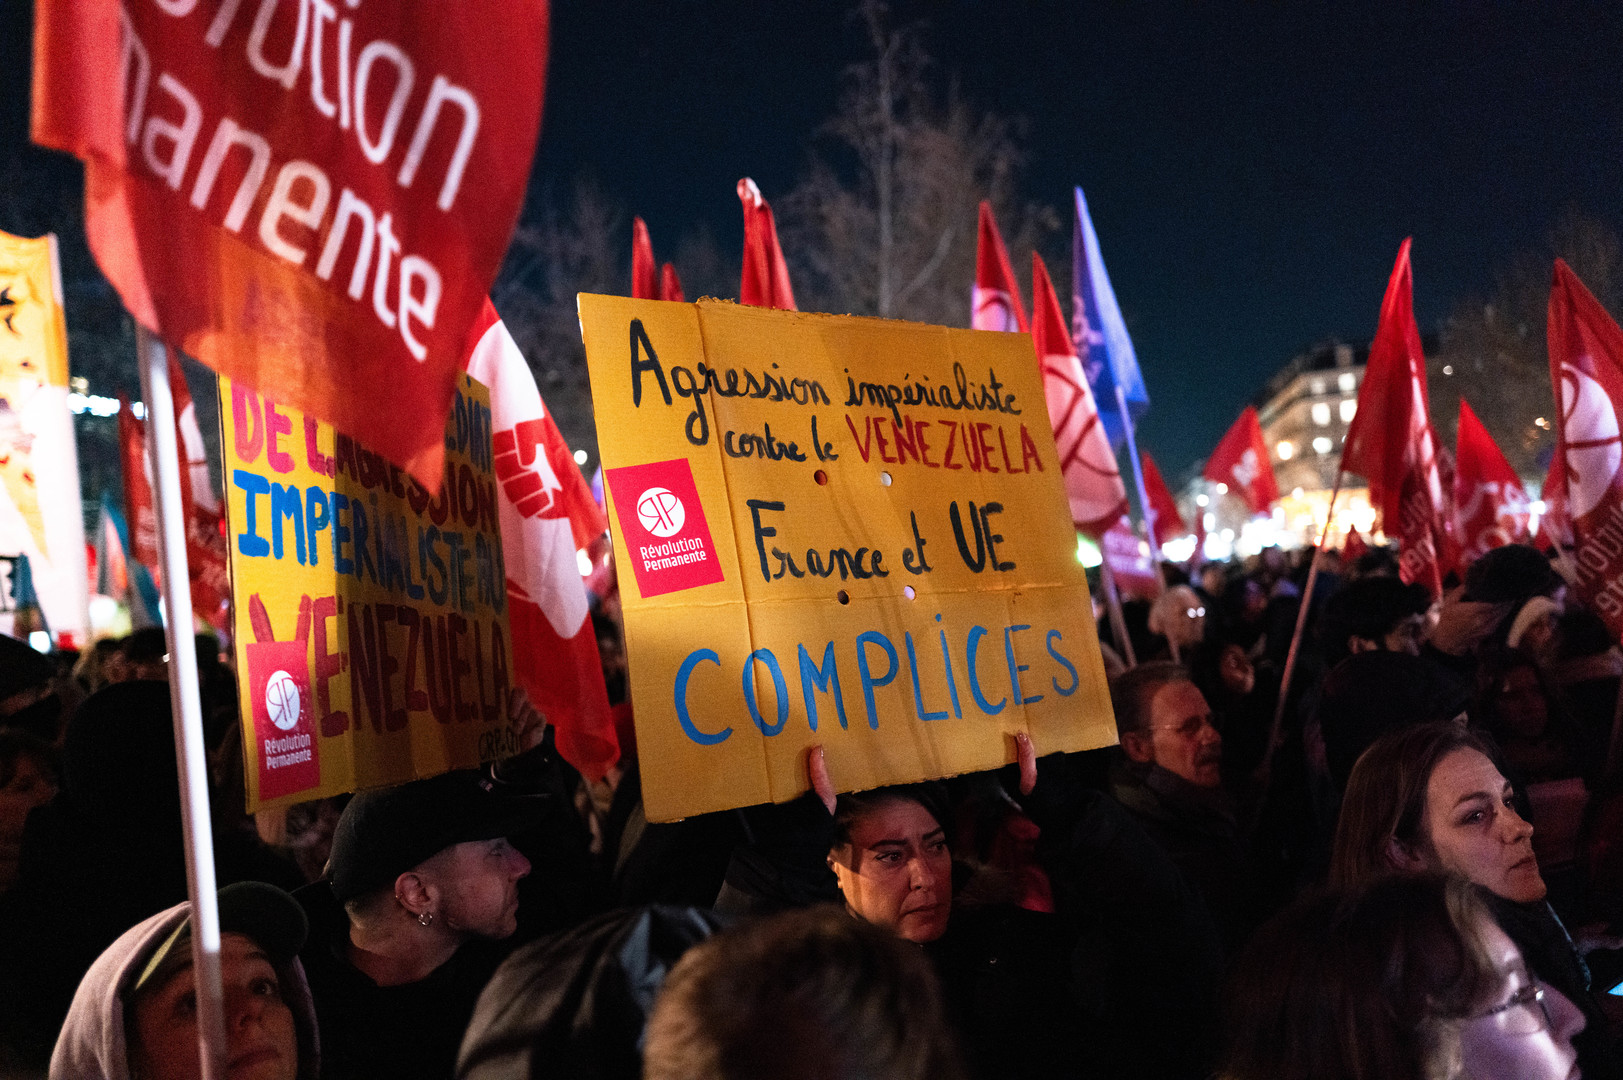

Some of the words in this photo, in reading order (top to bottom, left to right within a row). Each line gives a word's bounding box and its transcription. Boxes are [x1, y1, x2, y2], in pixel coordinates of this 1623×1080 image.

[155, 0, 481, 211] ution
[629, 318, 831, 446] Agression
[844, 361, 1022, 428] impérialiste
[231, 379, 296, 474] DE
[724, 421, 806, 462] contre
[810, 415, 839, 461] le
[845, 413, 1044, 475] VENEZUELA
[640, 537, 704, 560] Révolution
[644, 550, 707, 572] Permanente
[746, 499, 890, 583] France
[903, 510, 933, 575] et
[949, 500, 1016, 574] UE
[673, 613, 1080, 746] COMPLICES
[265, 733, 311, 755] Révolution
[266, 748, 312, 770] Permanente
